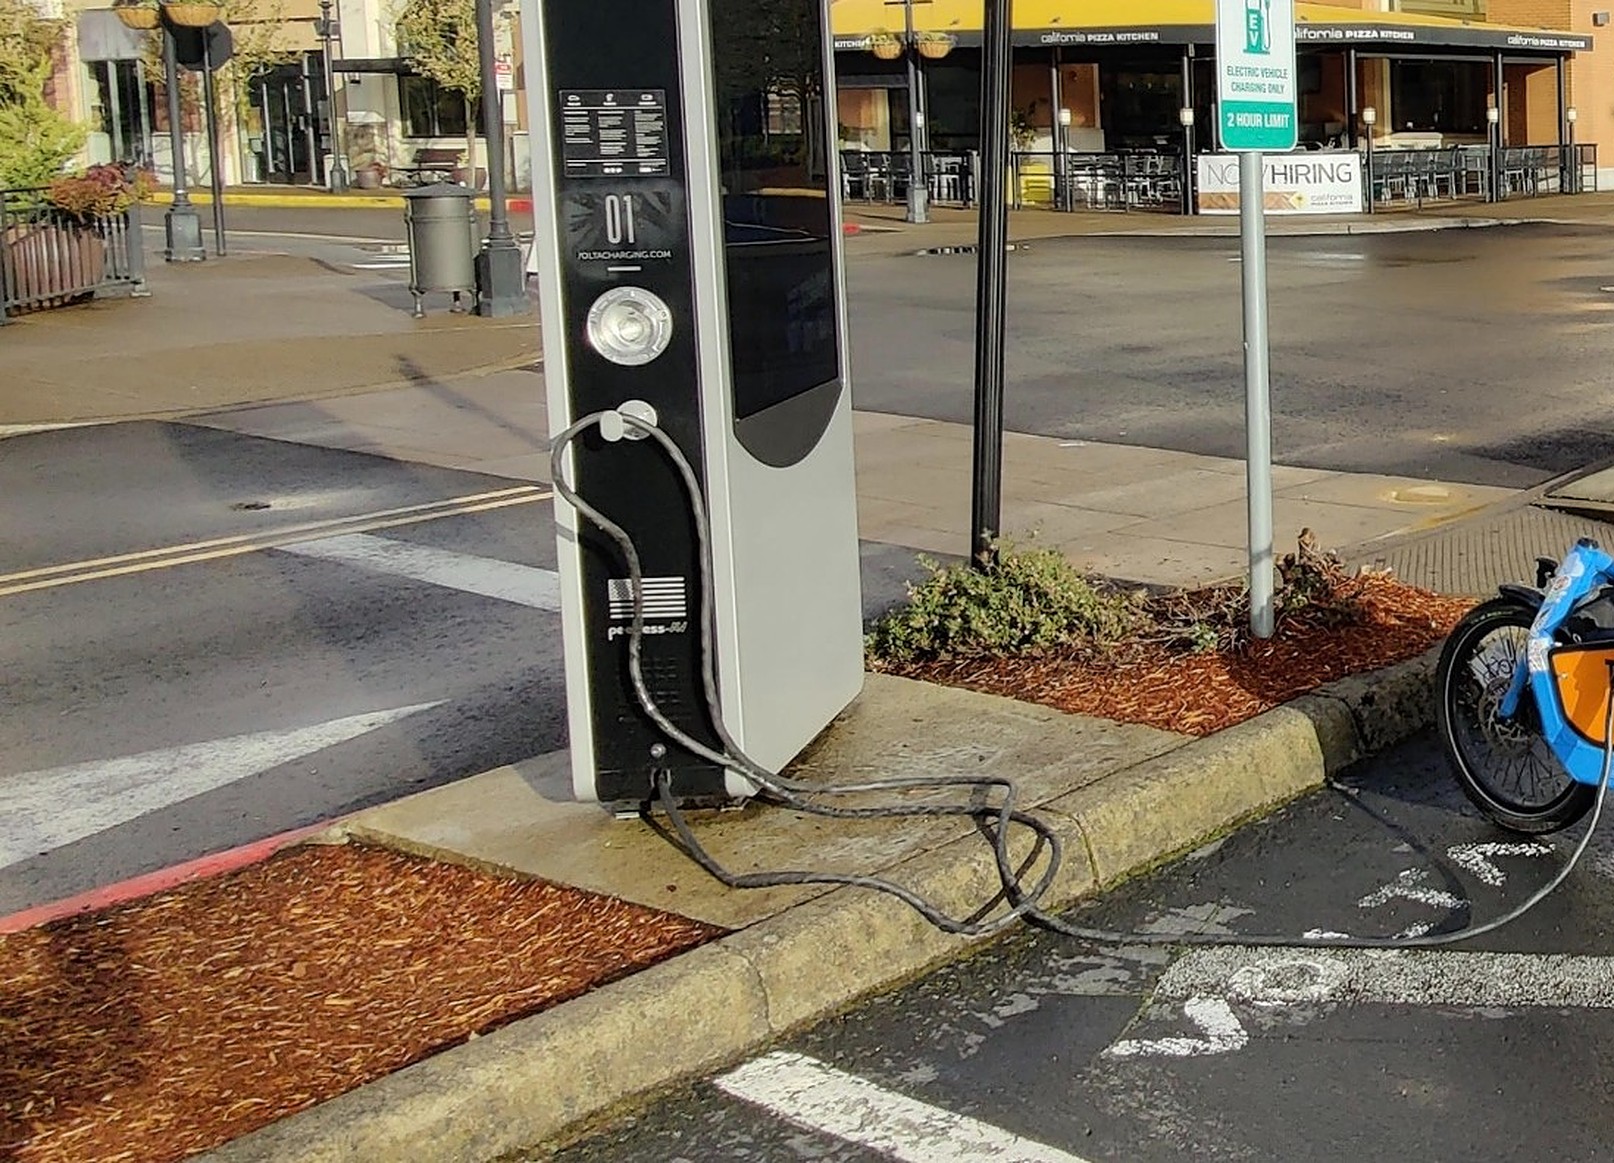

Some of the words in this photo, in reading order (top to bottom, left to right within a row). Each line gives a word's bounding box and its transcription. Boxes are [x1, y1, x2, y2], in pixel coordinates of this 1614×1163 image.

[1041, 31, 1086, 43] california
[1087, 33, 1114, 42] PIZZA
[1116, 32, 1158, 41] KITCHEN
[1380, 31, 1414, 39] KITCHEN
[1226, 66, 1259, 77] ELECTRIC
[1261, 67, 1288, 79] VEHICLE
[1231, 82, 1266, 93] CHARGING
[1268, 83, 1285, 94] ONLY
[1227, 113, 1234, 127] 2
[1236, 113, 1262, 127] HOUR
[1264, 114, 1289, 128] LIMIT
[1271, 163, 1352, 184] HIRING
[605, 194, 635, 244] 01
